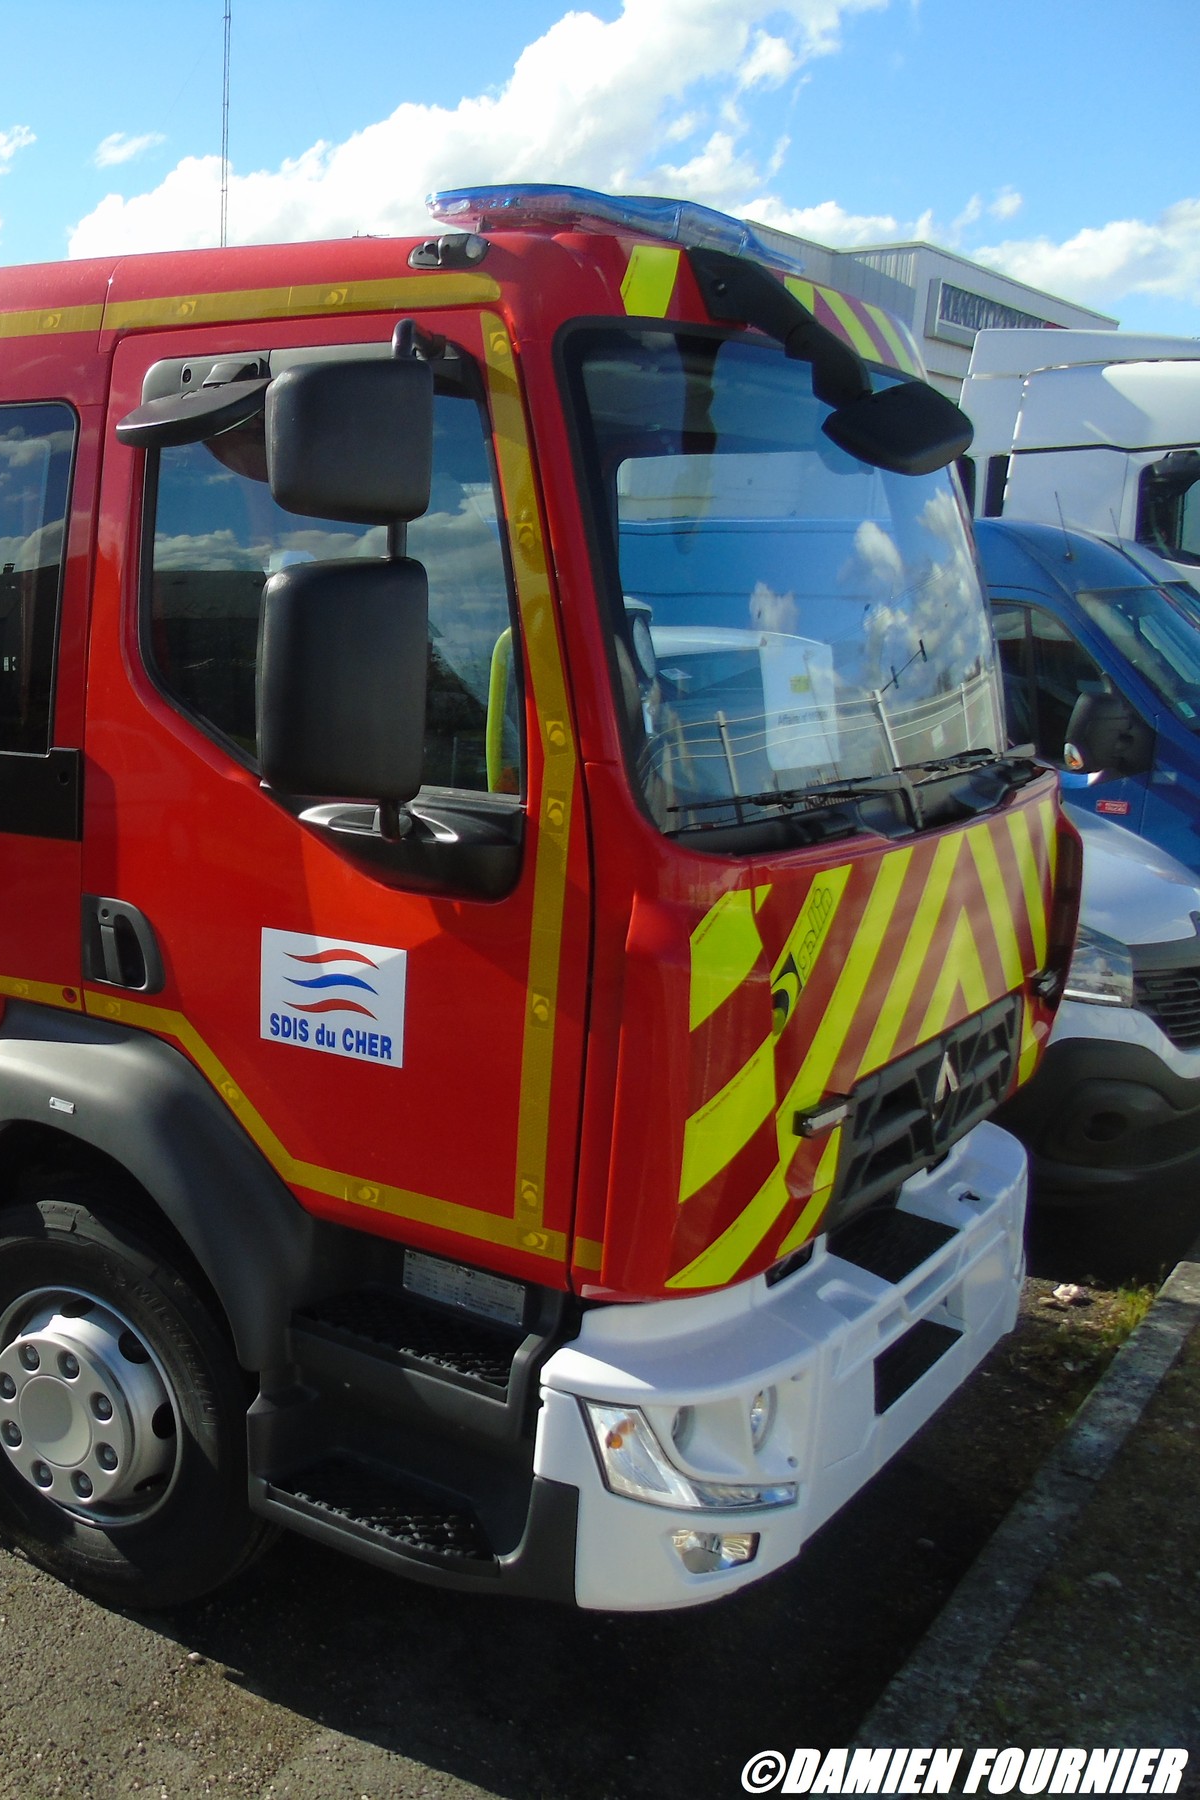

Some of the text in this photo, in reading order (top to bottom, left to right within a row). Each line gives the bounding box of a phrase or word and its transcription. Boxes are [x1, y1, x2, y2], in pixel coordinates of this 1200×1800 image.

[269, 1012, 392, 1060] SDIS du CHER
